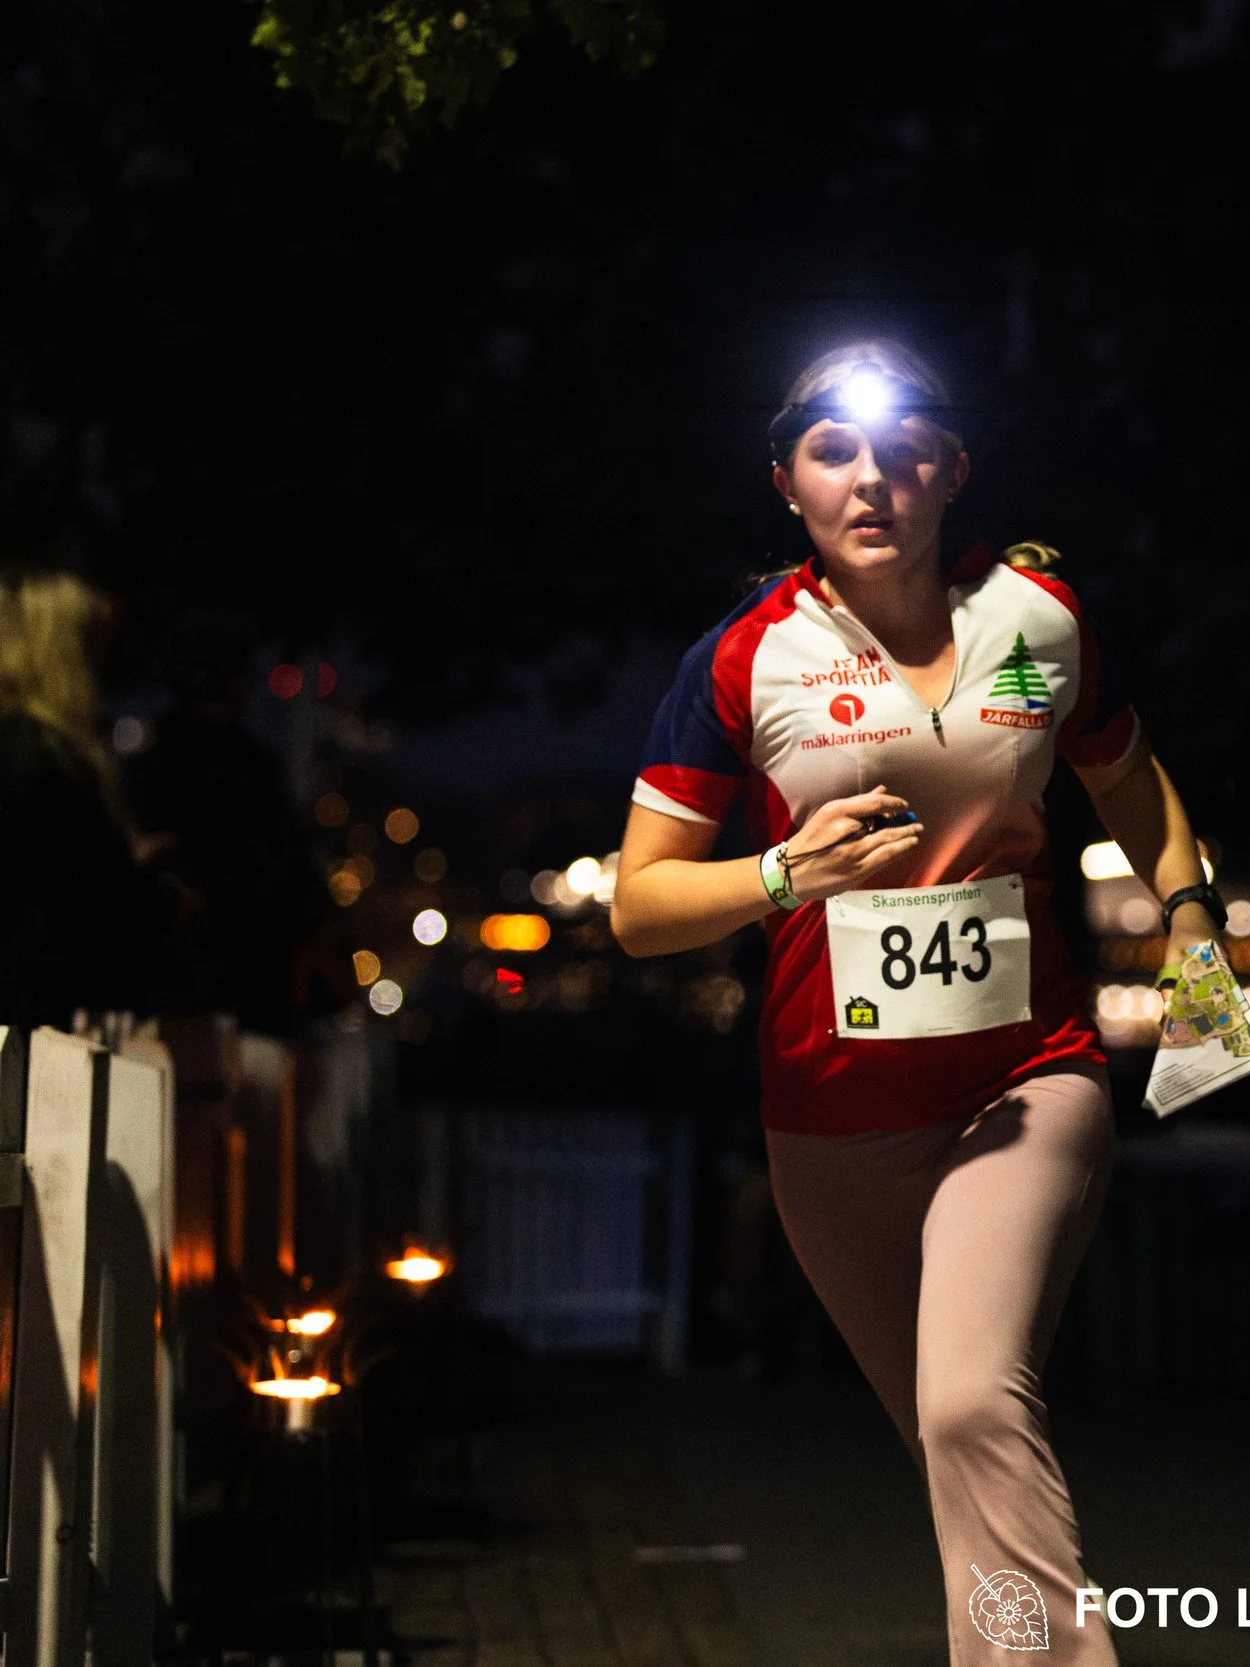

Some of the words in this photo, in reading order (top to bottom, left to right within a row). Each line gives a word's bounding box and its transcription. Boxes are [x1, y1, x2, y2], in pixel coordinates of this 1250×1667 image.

[801, 665, 892, 688] SPORTIA
[801, 725, 912, 750] mäklarringen
[871, 886, 982, 908] Skansensprinten
[880, 916, 992, 990] 843
